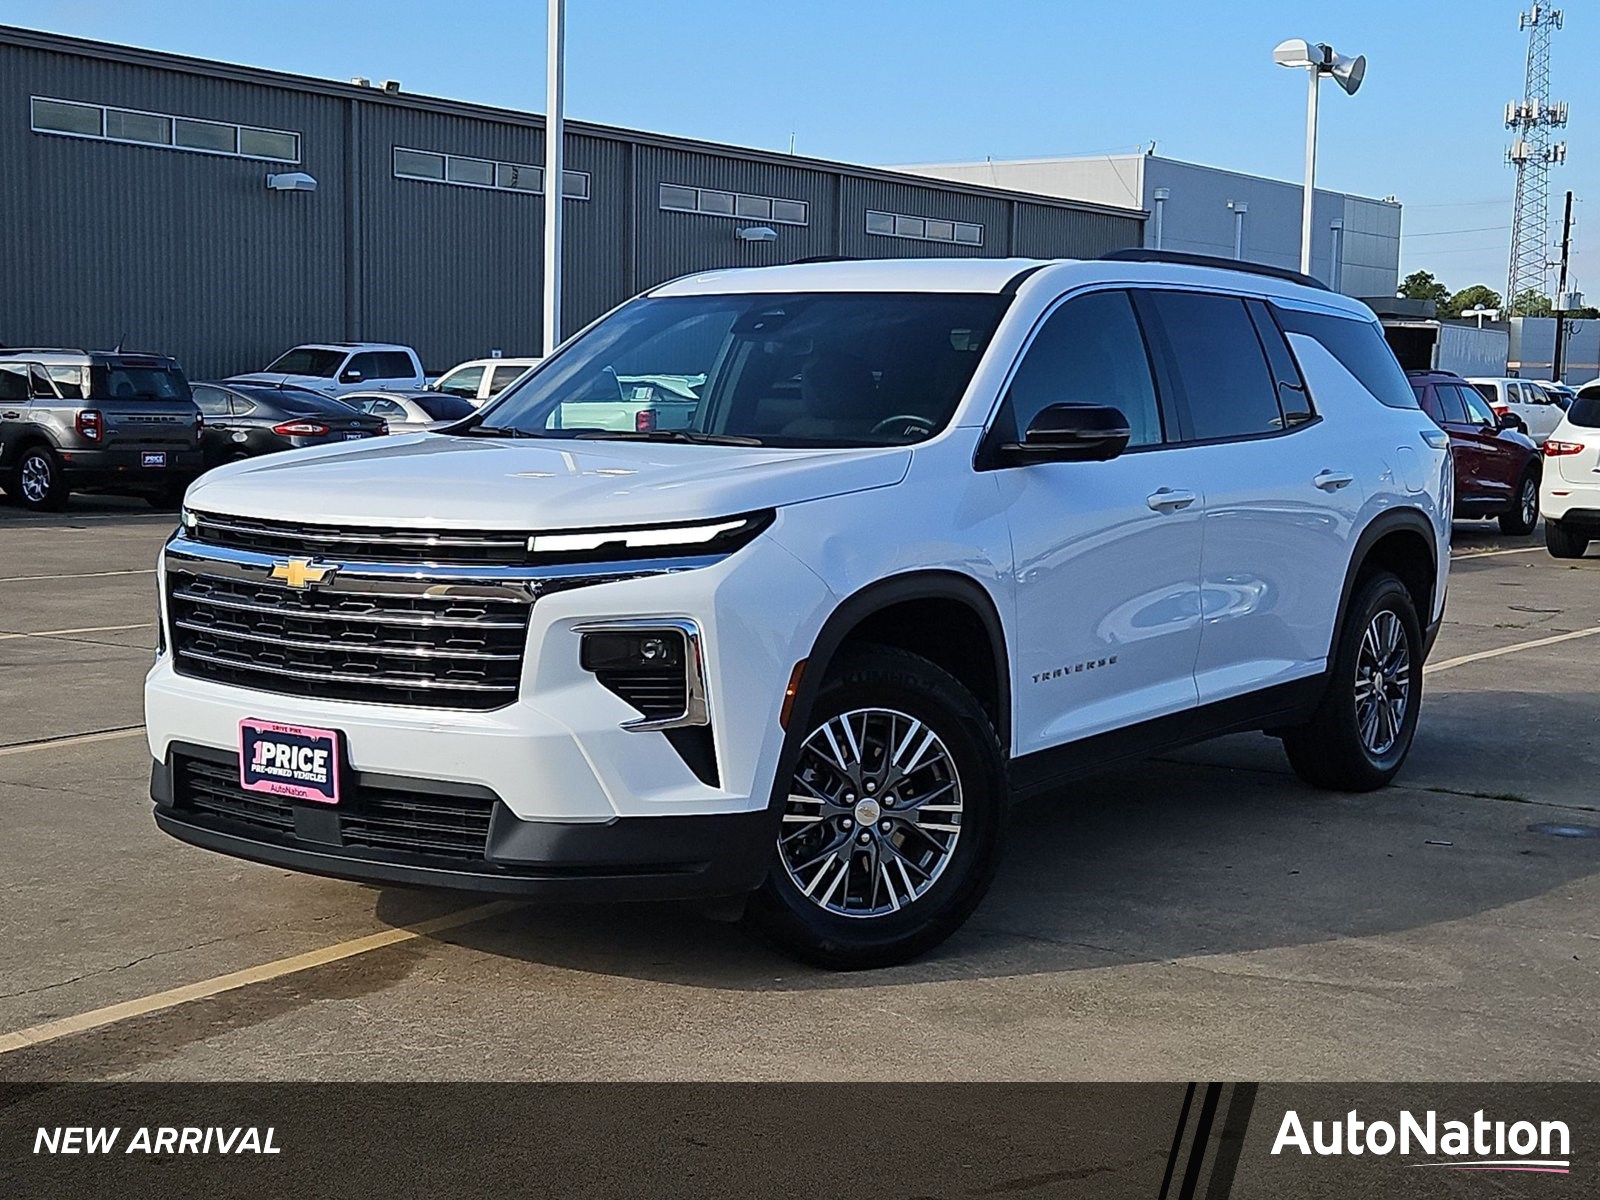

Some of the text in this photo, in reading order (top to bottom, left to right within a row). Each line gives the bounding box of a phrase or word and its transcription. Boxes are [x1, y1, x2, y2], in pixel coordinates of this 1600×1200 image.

[1032, 656, 1118, 683] TRAVERSE
[251, 764, 327, 783] PRE-OWNED VEHICLES
[270, 784, 308, 797] AutoNation
